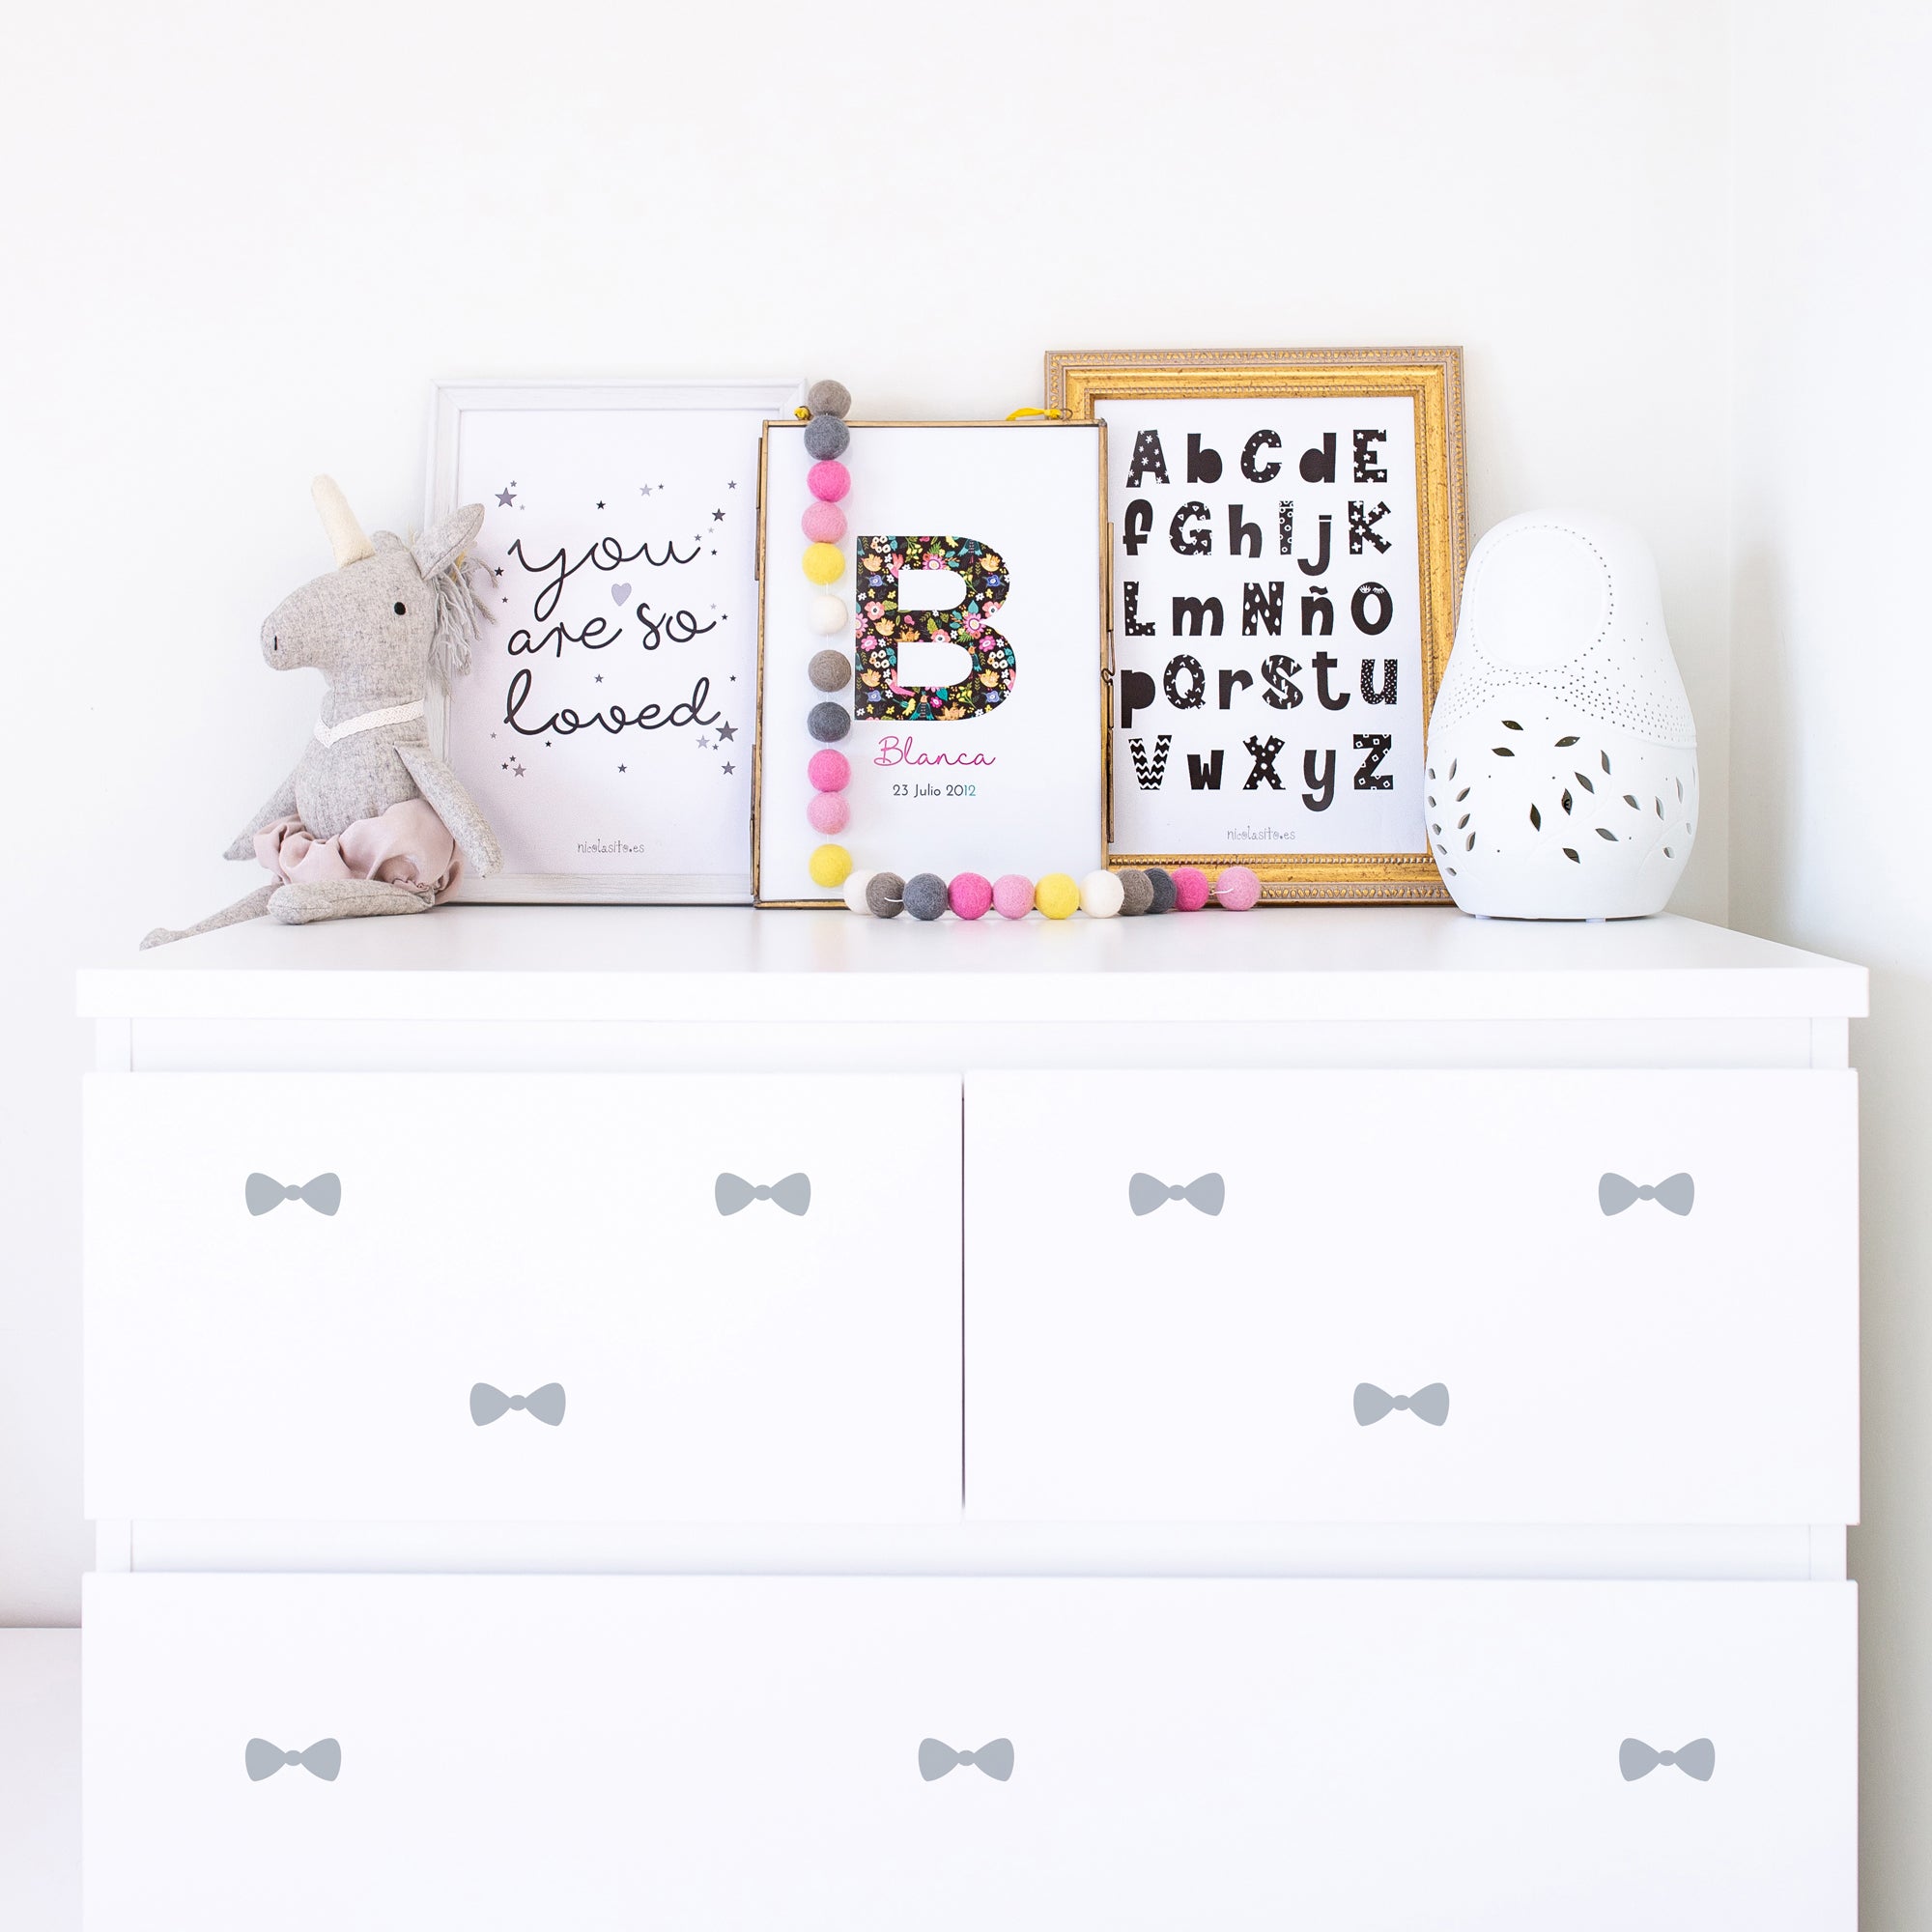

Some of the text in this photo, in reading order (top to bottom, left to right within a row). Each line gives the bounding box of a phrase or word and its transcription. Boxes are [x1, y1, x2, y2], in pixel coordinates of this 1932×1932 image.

[507, 537, 701, 622] you
[507, 602, 717, 658] are so
[854, 536, 1017, 722] B
[503, 668, 722, 736] loved
[873, 735, 997, 768] Blanca
[892, 782, 977, 799] 23 Julio 2012
[577, 838, 646, 854] nicolasito.es
[1227, 825, 1296, 840] nicolasito.es
